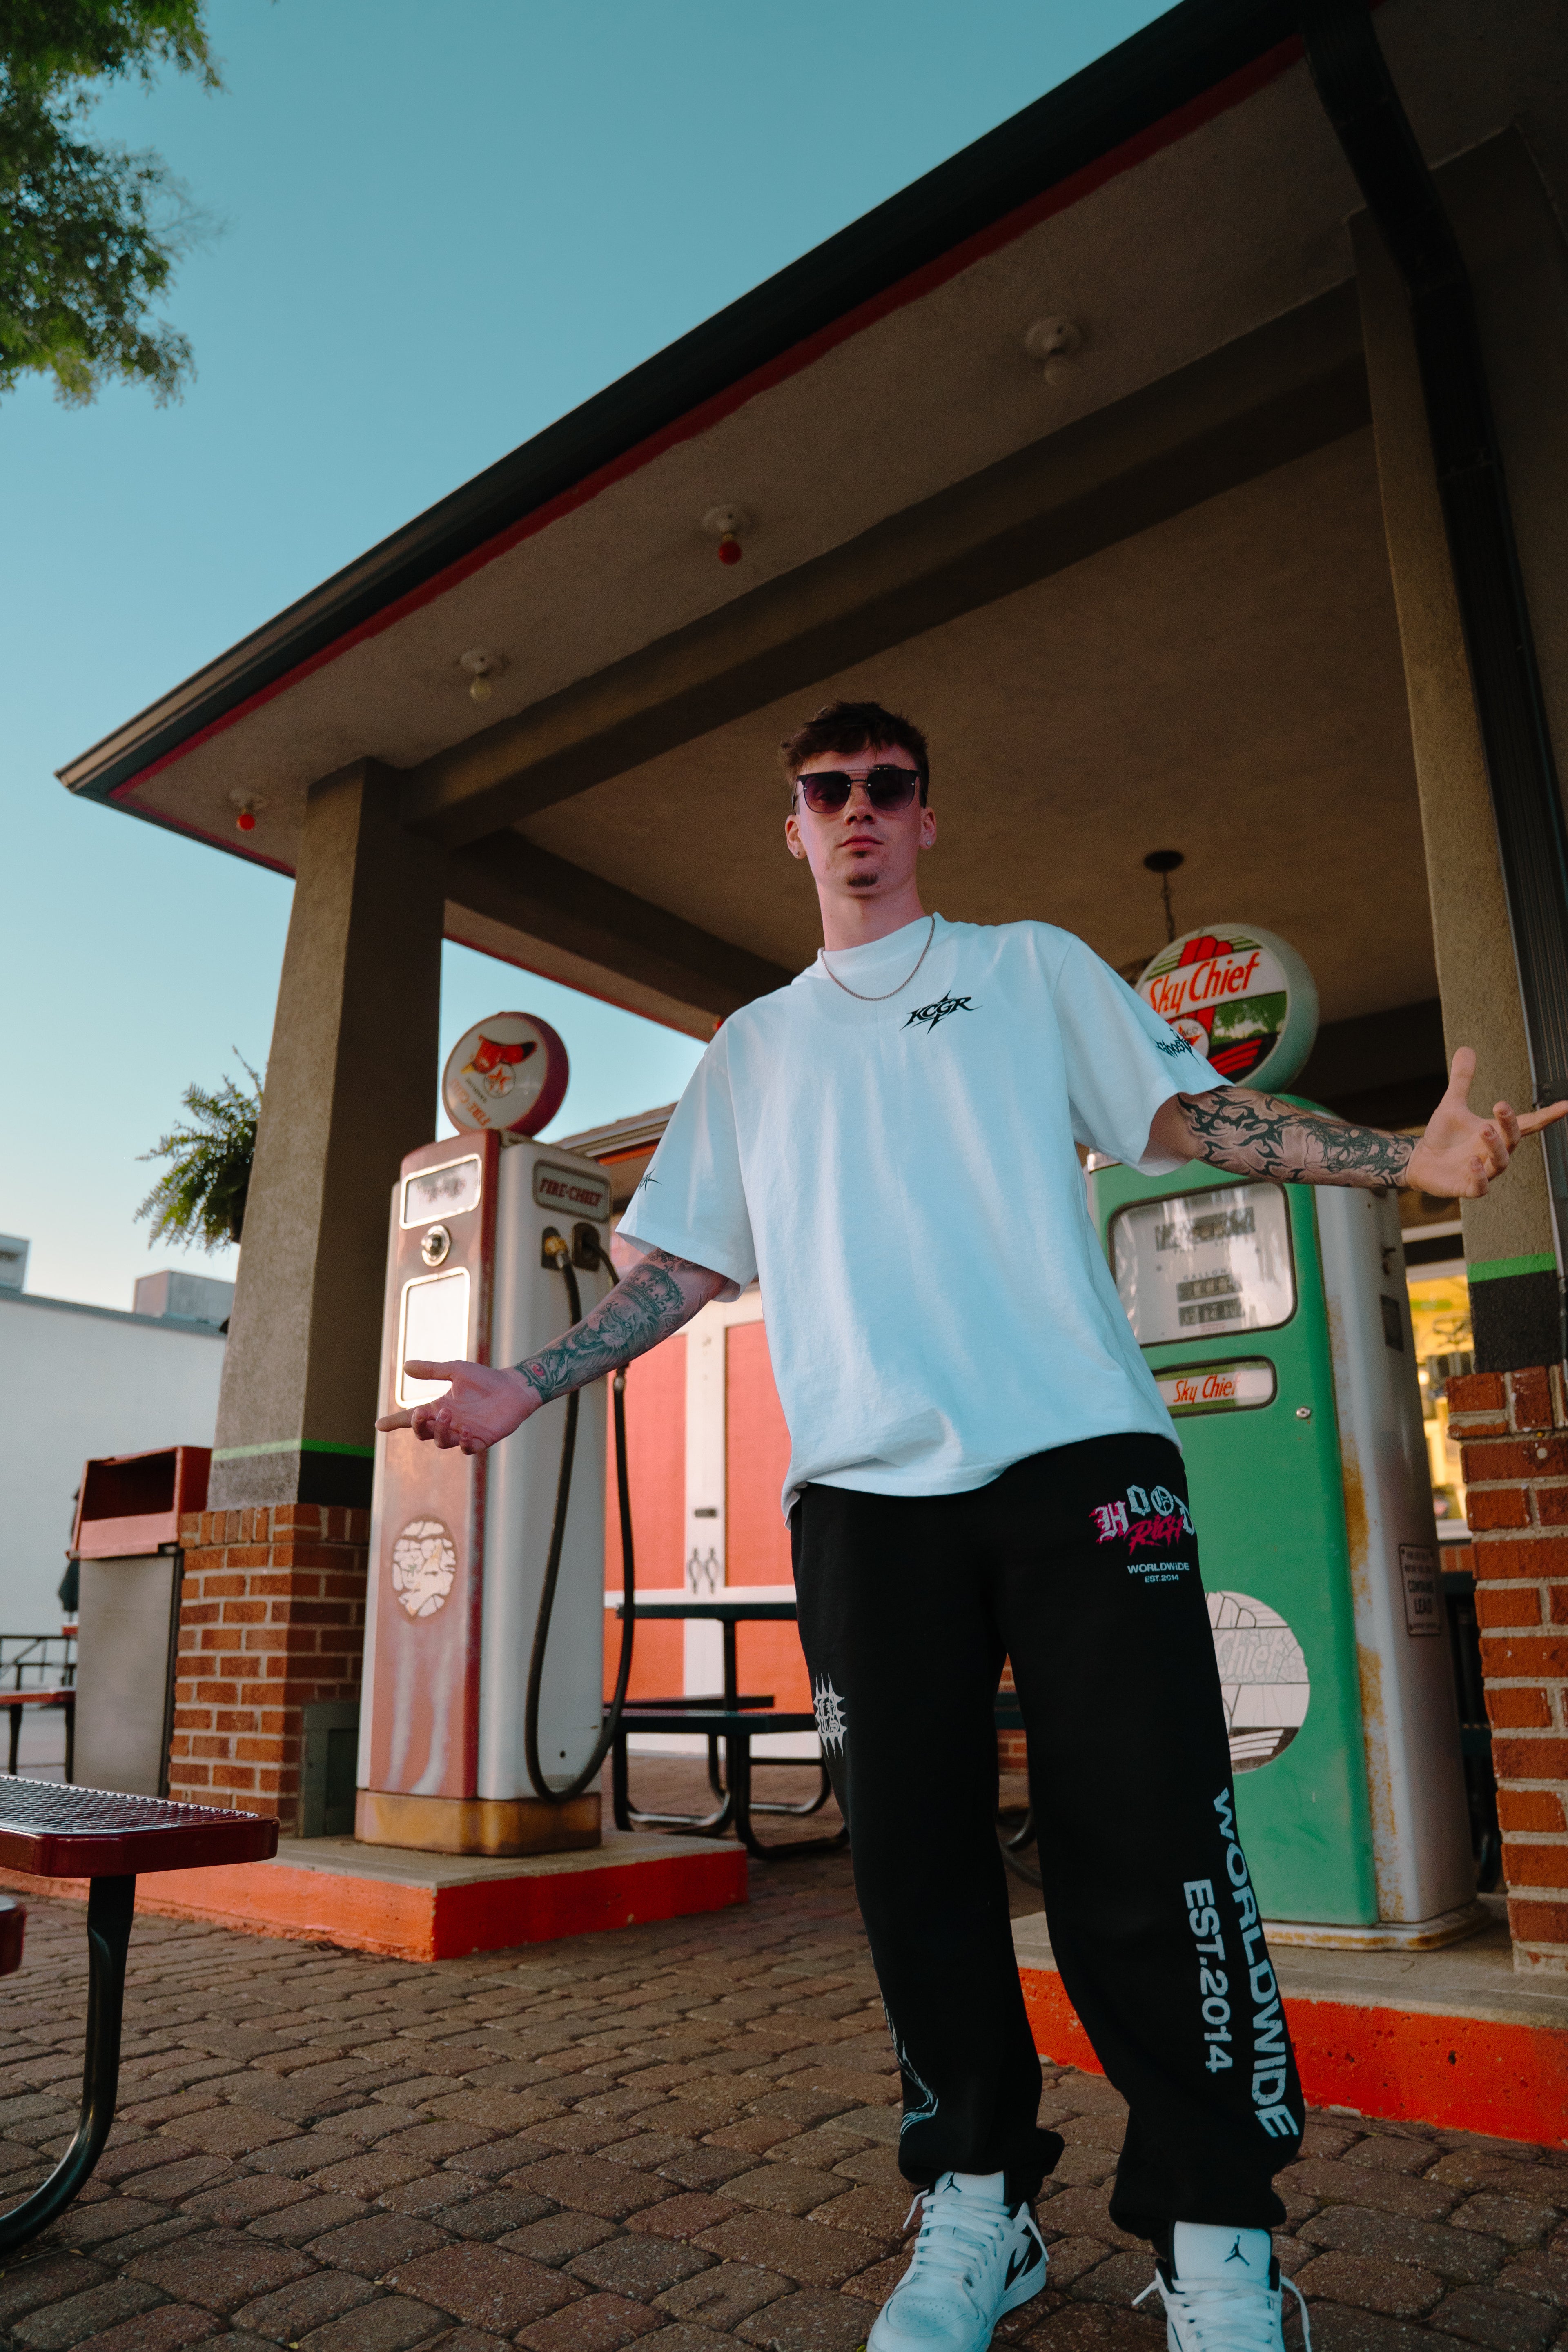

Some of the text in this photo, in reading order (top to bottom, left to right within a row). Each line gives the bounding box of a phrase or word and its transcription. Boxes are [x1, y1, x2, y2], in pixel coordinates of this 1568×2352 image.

[1149, 951, 1260, 1014] Sky Chief
[1173, 1380, 1198, 1404] Sky
[1183, 1879, 1233, 2074] EST.2014
[1213, 1787, 1299, 2139] WORLDWIDE
